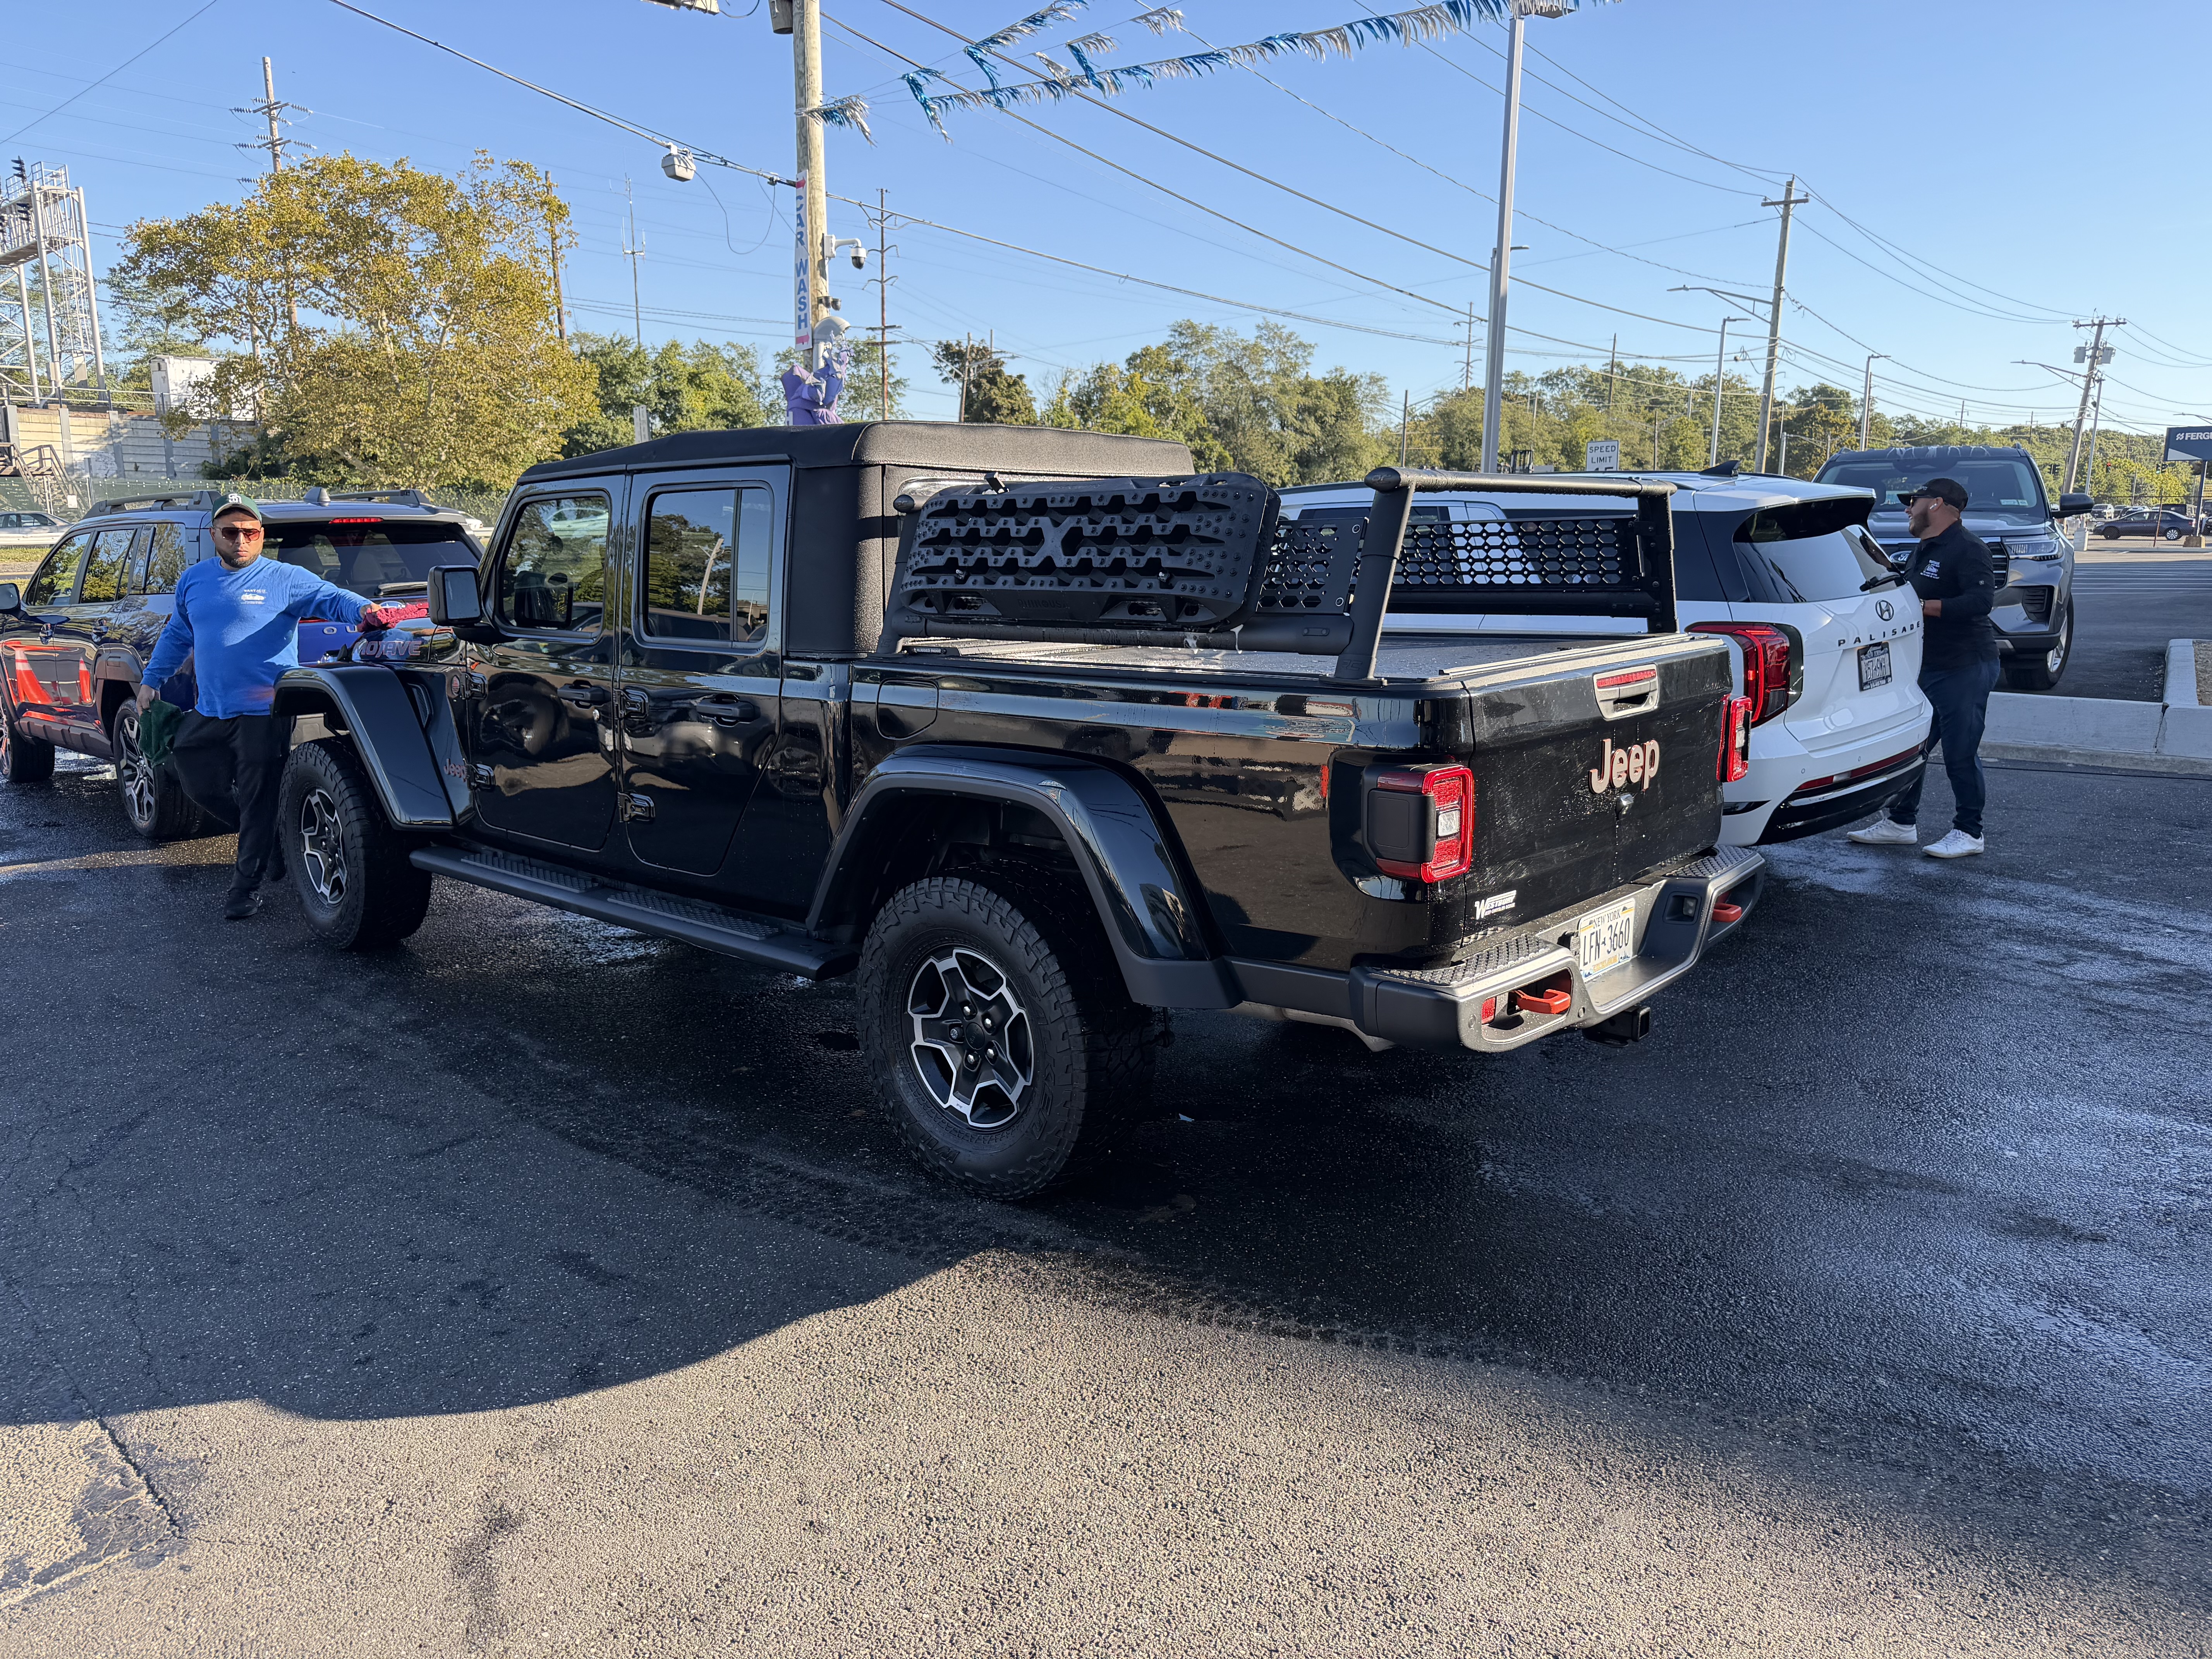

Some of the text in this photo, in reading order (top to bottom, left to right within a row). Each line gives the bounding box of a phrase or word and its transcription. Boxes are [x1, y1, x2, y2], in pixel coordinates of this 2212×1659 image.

[795, 195, 808, 330] CAR WASH
[1589, 445, 1616, 453] SPEED
[1591, 455, 1613, 464] LIMIT
[1838, 621, 1920, 647] PALISADE
[353, 641, 422, 658] MOJAVE
[443, 758, 467, 782] Jeep
[1588, 738, 1660, 794] Jeep
[1593, 908, 1621, 929] NEW YORK
